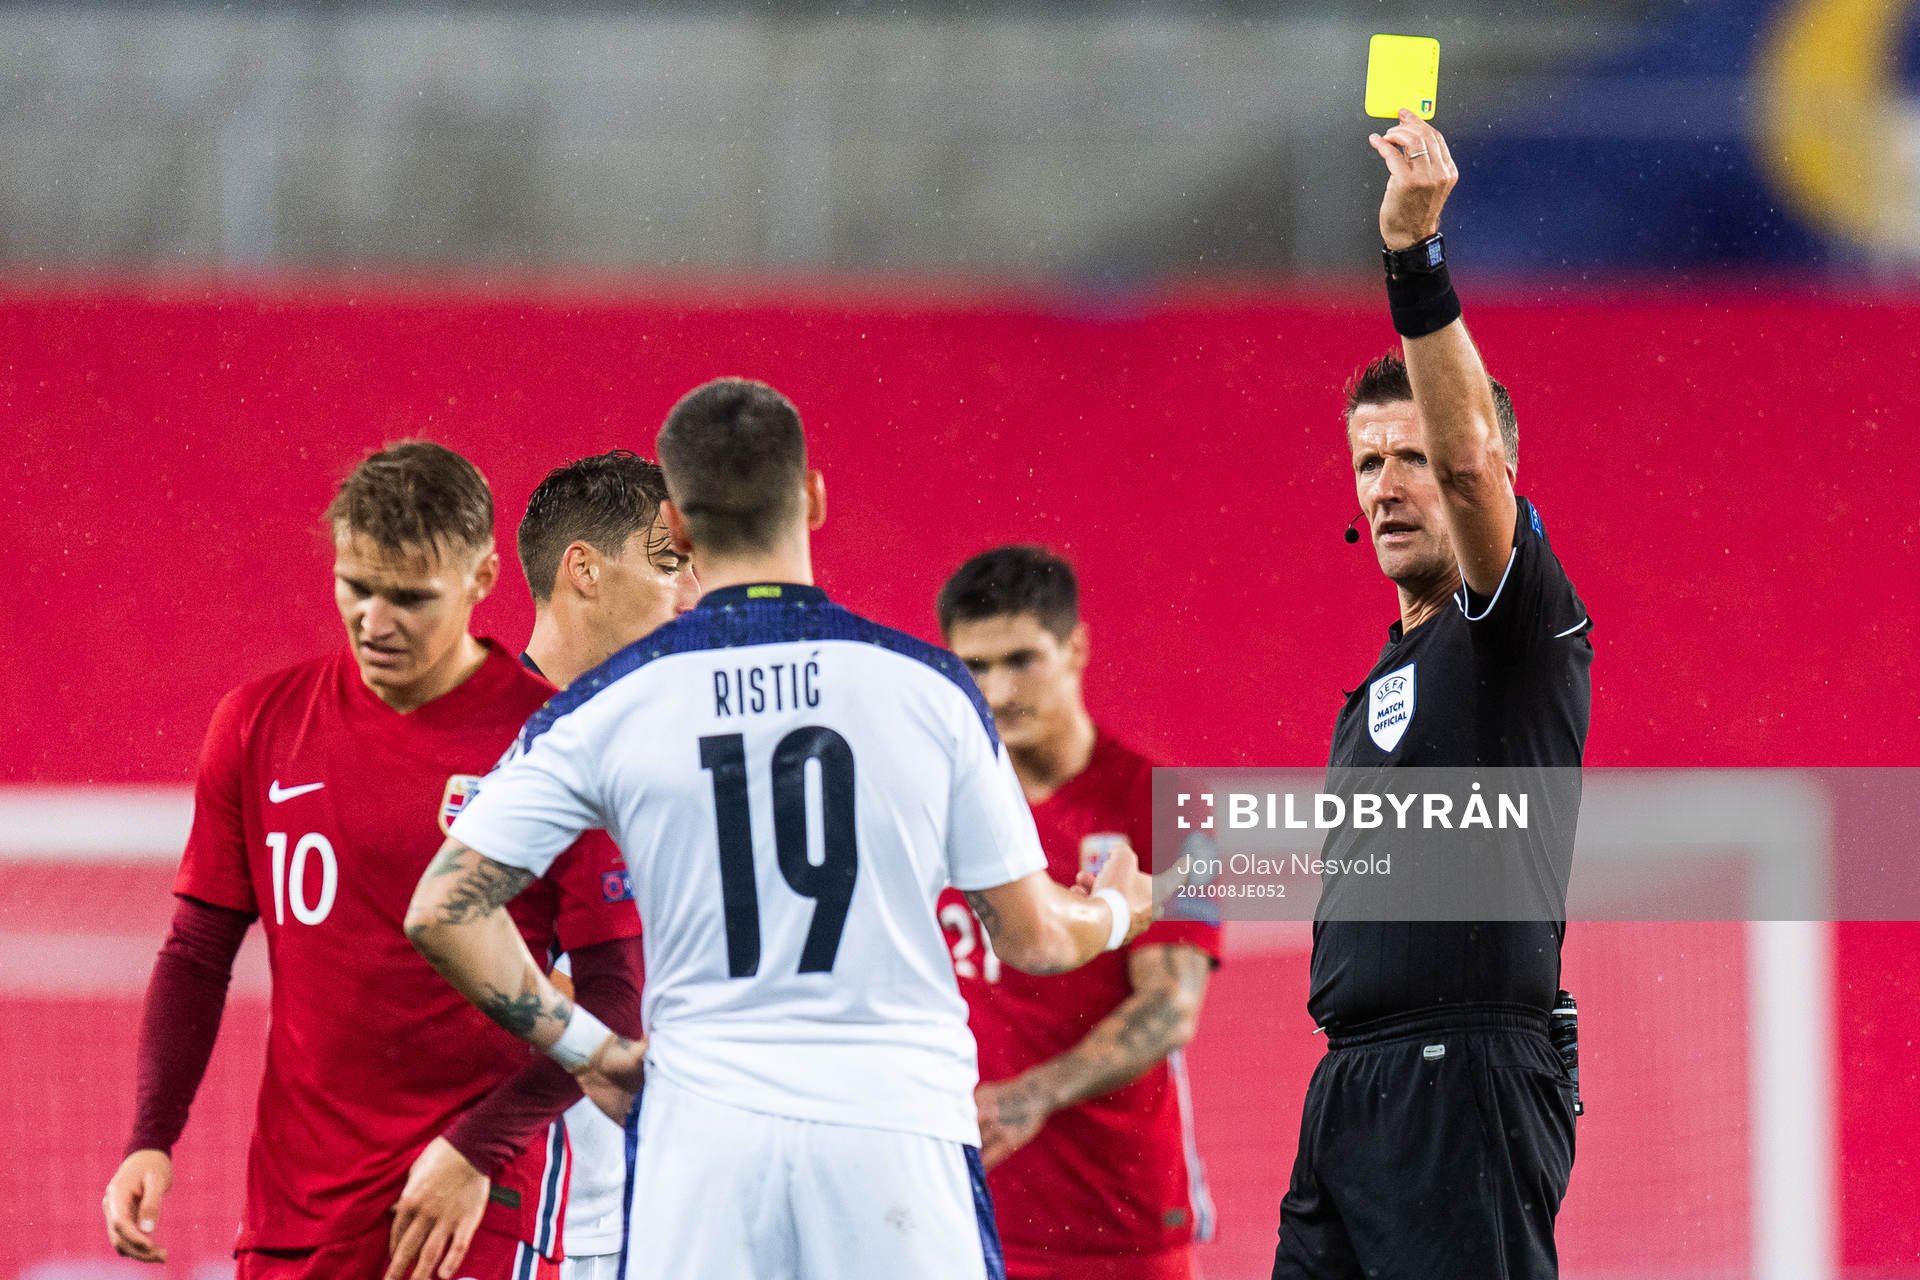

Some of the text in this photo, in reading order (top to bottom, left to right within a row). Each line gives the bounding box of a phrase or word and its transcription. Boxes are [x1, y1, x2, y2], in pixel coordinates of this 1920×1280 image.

[713, 650, 821, 717] RISTIĆ
[1376, 679, 1404, 700] UEFA
[1373, 711, 1408, 733] OFFICIAL
[1377, 700, 1404, 719] MATCH
[698, 725, 858, 979] 19
[266, 832, 338, 926] 10
